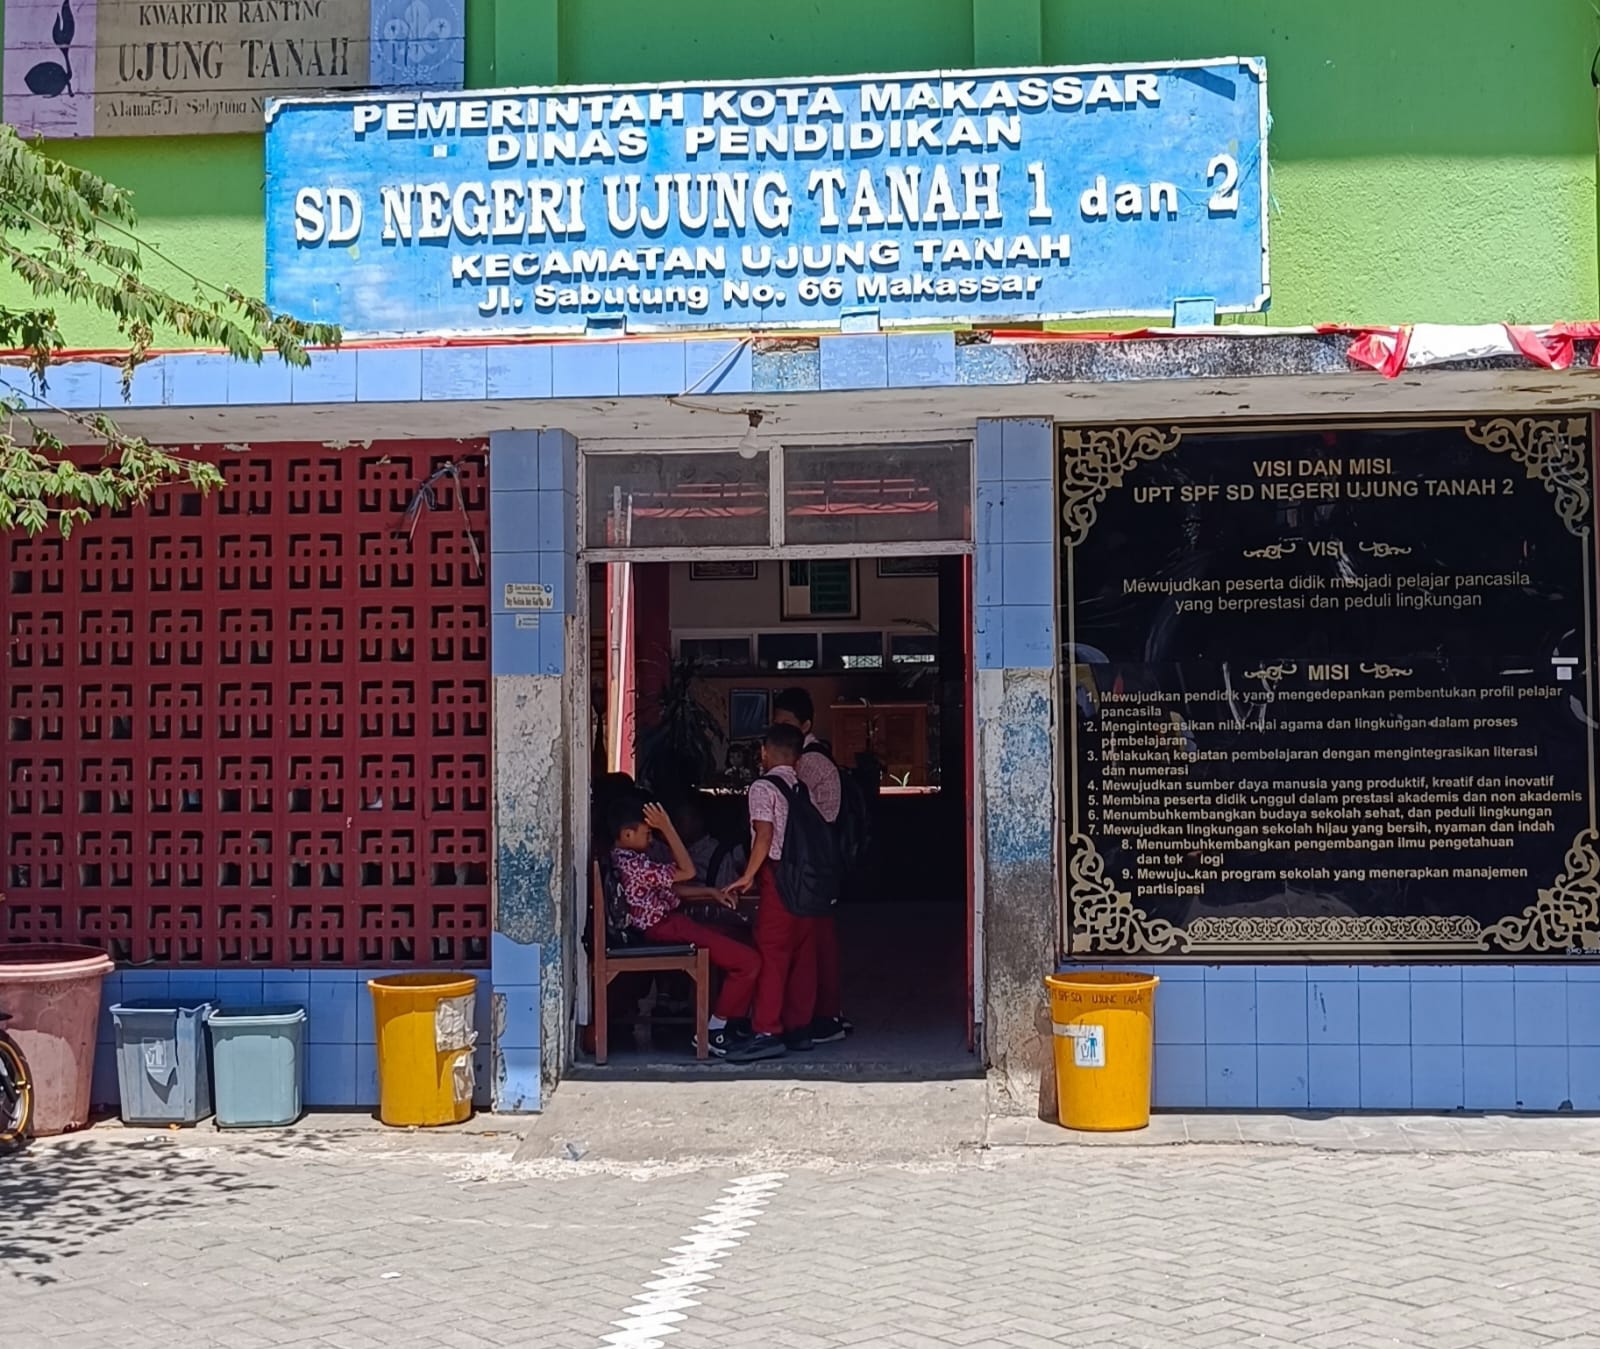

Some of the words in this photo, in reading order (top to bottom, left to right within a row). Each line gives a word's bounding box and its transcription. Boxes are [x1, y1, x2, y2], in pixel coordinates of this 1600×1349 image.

[140, 2, 228, 26] KWARTIR
[118, 40, 223, 82] UJUNG
[240, 37, 349, 79] TANAH
[353, 92, 684, 134] PEMERINTAH
[703, 86, 843, 121] KOTA
[860, 73, 1161, 110] MAKASSAR
[487, 128, 648, 164] DINAS
[685, 115, 1022, 155] PENDIDIKAN
[294, 187, 363, 243] SD
[381, 178, 586, 240] NEGERI
[603, 167, 793, 233] UJUNG
[808, 163, 1003, 228] TANAH
[1028, 161, 1053, 218] 1
[1079, 175, 1179, 217] dan
[1206, 154, 1240, 213] 2
[451, 246, 726, 280] KECAMATAN
[742, 238, 900, 272] UJUNG
[914, 233, 1071, 264] TANAH
[478, 286, 523, 313] Jl.
[535, 282, 709, 311] Sabutung
[723, 280, 785, 304] No.
[798, 275, 842, 300] 66
[855, 272, 1043, 299] Makassar
[1252, 460, 1291, 476] VISI
[1298, 459, 1342, 475] DAN
[1349, 458, 1391, 475] MISI
[1134, 486, 1174, 502] UPT
[1180, 485, 1220, 501] SPF
[1226, 484, 1254, 500] SD
[1260, 482, 1339, 499] NEGERI
[1346, 480, 1418, 497] UJUNG
[1424, 479, 1495, 495] TANAH
[1502, 478, 1513, 494] 2
[1308, 541, 1344, 557] VISI
[1123, 577, 1220, 594] Mewujudkan
[1225, 577, 1284, 593] peserta
[1288, 575, 1325, 589] didik
[1396, 573, 1450, 592] pelajar
[1455, 571, 1531, 588] pancasila
[1174, 599, 1213, 614] yang
[1218, 594, 1304, 612] berprestasi
[1309, 594, 1339, 608] dan
[1344, 593, 1391, 611] peduli
[1396, 592, 1482, 611] lingkungan
[1307, 664, 1350, 681] MISI
[1100, 689, 1180, 704] Mewujudkan
[1242, 686, 1276, 703] yang
[1278, 688, 1384, 701] mengedepankan
[1388, 687, 1476, 700] pembentukan
[1480, 685, 1514, 698] profil
[1518, 685, 1562, 698] pelajar
[1101, 705, 1162, 719] pancasila
[1086, 721, 1097, 731] 2.
[1101, 719, 1214, 734] Mengintegrasikan
[1280, 720, 1323, 731] agama
[1326, 718, 1350, 729] dan
[1354, 717, 1426, 731] lingkungan
[1430, 716, 1469, 728] dalam
[1473, 718, 1518, 728] proses
[1101, 733, 1188, 749] pembelajaran
[1087, 750, 1098, 761] 3.
[1101, 749, 1169, 761] Melakukan
[1173, 748, 1228, 762] kegiatan
[1231, 748, 1318, 761] pembelajaran
[1322, 748, 1370, 761] dengan
[1374, 746, 1490, 760] mengintegrasikan
[1493, 745, 1537, 756] literasi
[1102, 763, 1125, 775] dan
[1129, 764, 1188, 775] numerasi
[1087, 779, 1098, 790] 4.
[1102, 779, 1182, 792] Mewujudkan
[1185, 779, 1234, 789] sumber
[1238, 778, 1268, 792] daya
[1272, 778, 1327, 788] manusia
[1330, 779, 1362, 791] yang
[1366, 776, 1428, 790] produktif,
[1432, 775, 1473, 787] kreatif
[1476, 776, 1500, 786] dan
[1504, 775, 1554, 787] inovatif
[1088, 794, 1098, 805] 5.
[1102, 794, 1160, 805] Membina
[1163, 794, 1211, 806] peserta
[1215, 793, 1246, 804] didik
[1298, 792, 1338, 803] dalam
[1342, 792, 1393, 805] prestasi
[1397, 791, 1459, 802] akademis
[1462, 791, 1486, 801] dan
[1490, 793, 1516, 801] non
[1519, 790, 1582, 801] akademis
[1087, 809, 1099, 820] 6.
[1102, 808, 1256, 821] Menumbuhkembangkan
[1259, 808, 1307, 821] budaya
[1310, 807, 1361, 818] sekolah
[1364, 807, 1404, 818] sehat,
[1407, 806, 1431, 817] dan
[1435, 806, 1475, 819] peduli
[1479, 806, 1552, 819] lingkungan
[1088, 823, 1099, 835] 7.
[1103, 823, 1183, 836] Mewujudkan
[1186, 823, 1258, 837] lingkungan
[1261, 822, 1312, 834] sekolah
[1316, 822, 1348, 835] hijau
[1351, 824, 1383, 835] yang
[1386, 821, 1431, 833] bersih,
[1434, 823, 1486, 834] nyaman
[1489, 821, 1514, 831] dan
[1518, 820, 1554, 831] indah
[1121, 838, 1132, 849] 8.
[1136, 838, 1290, 852] Menumbuhkembangkan
[1294, 838, 1394, 851] pengembangan
[1397, 836, 1425, 847] ilmu
[1429, 836, 1514, 849] pengetahuan
[1137, 853, 1161, 864] dan
[1164, 853, 1224, 867] teklogi
[1121, 868, 1133, 879] 9.
[1137, 868, 1217, 881] Mewujukan
[1221, 870, 1276, 881] program
[1279, 867, 1330, 878] sekolah
[1333, 869, 1365, 880] yang
[1368, 867, 1448, 879] menerapkan
[1452, 866, 1528, 879] manajemen
[1137, 882, 1204, 896] partisipasi
